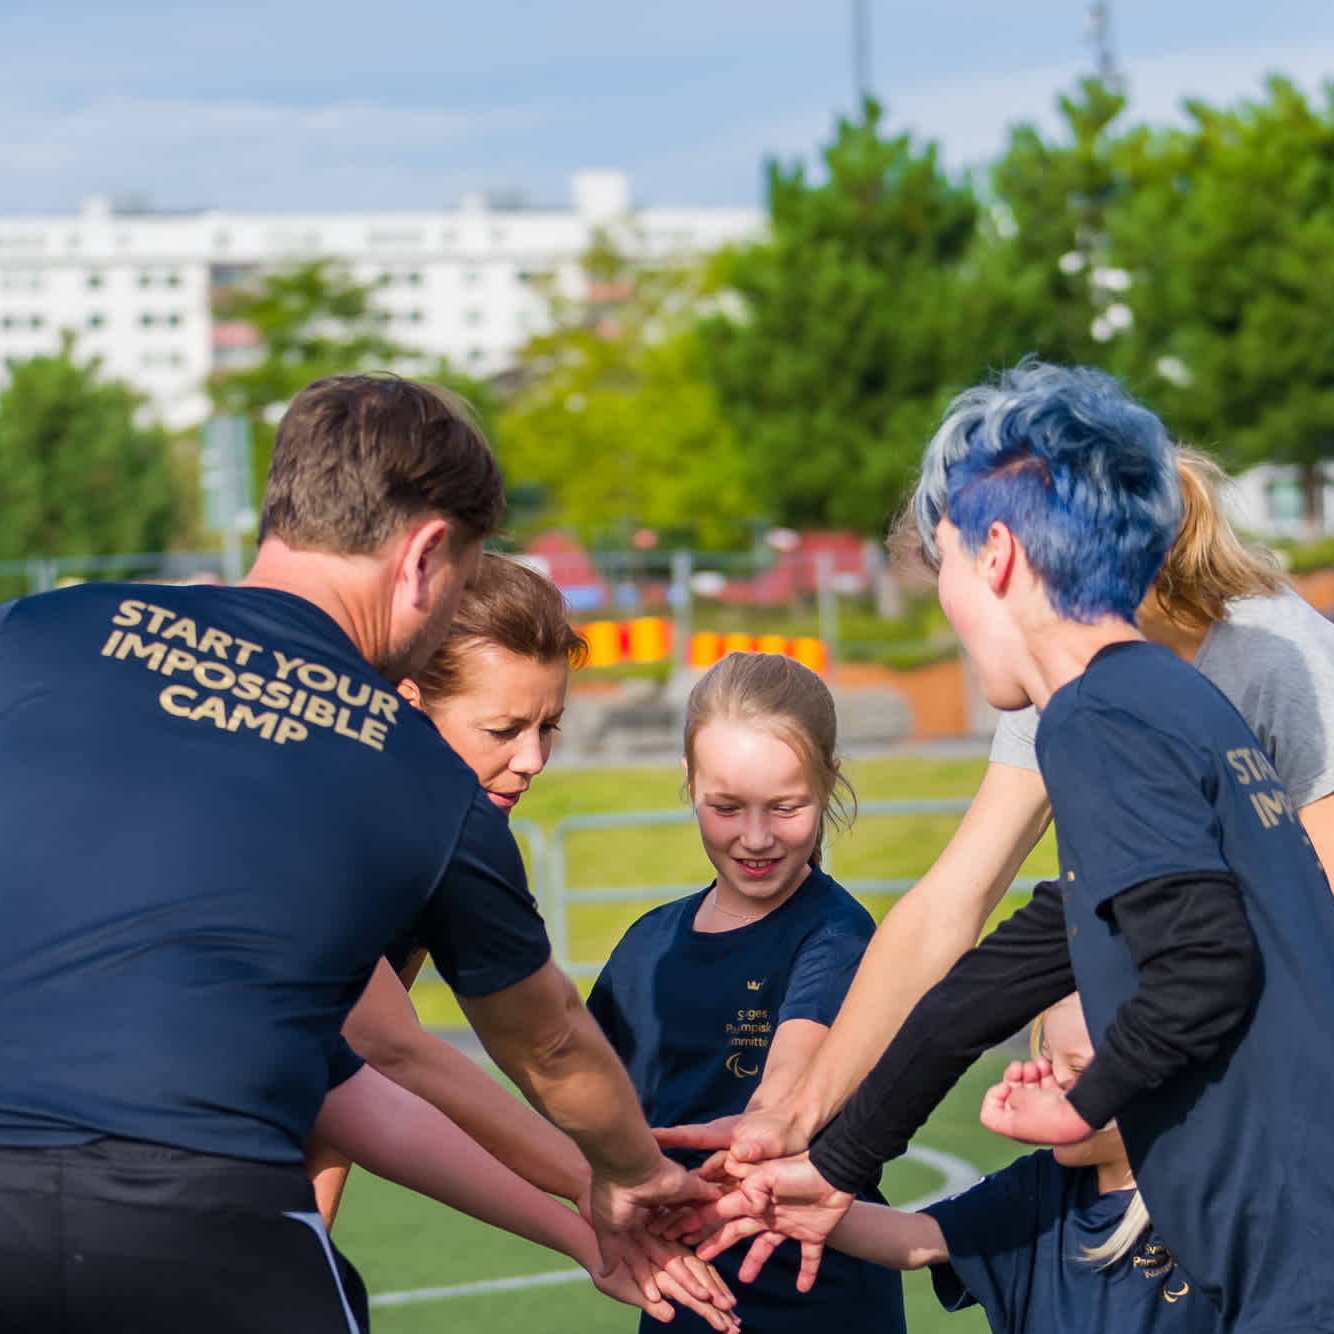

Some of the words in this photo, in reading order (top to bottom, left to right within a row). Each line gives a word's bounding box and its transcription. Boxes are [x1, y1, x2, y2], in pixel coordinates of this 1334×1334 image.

[100, 629, 389, 752] IMPOSSIBLE
[112, 599, 263, 666] START
[272, 650, 400, 725] YOUR
[157, 683, 309, 745] CAMP
